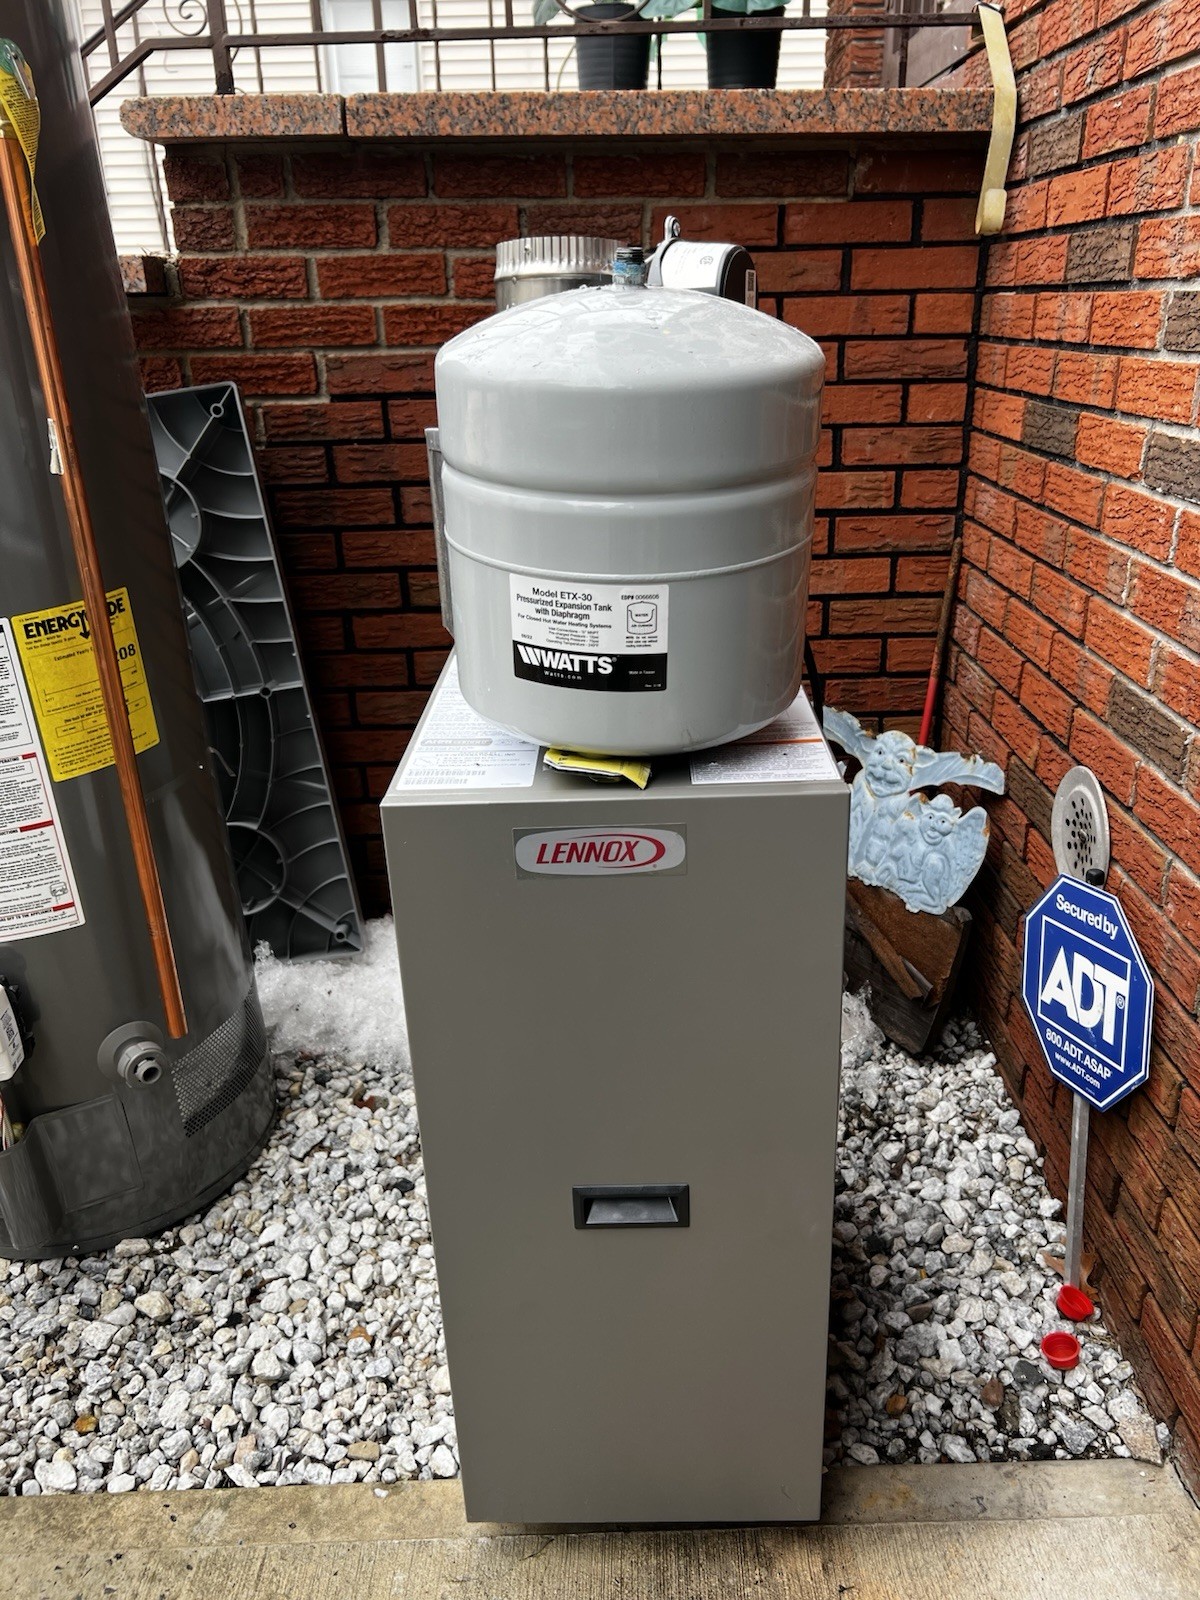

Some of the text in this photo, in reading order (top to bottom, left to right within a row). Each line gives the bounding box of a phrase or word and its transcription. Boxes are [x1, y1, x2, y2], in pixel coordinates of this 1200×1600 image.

[516, 594, 612, 612] Pressurized Expansion Tank
[532, 588, 593, 601] Model ETX-30
[526, 614, 542, 622] Closed
[535, 607, 590, 621] with Diaphragm
[540, 650, 613, 674] WATTS
[544, 670, 582, 680] Watts.com
[536, 840, 640, 864] LENNOX
[1056, 894, 1119, 940] Secured by
[1040, 945, 1128, 1046] ADT
[1046, 1028, 1111, 1079] 800.ADT.ASAP
[1055, 1052, 1101, 1089] www.ADT.com
